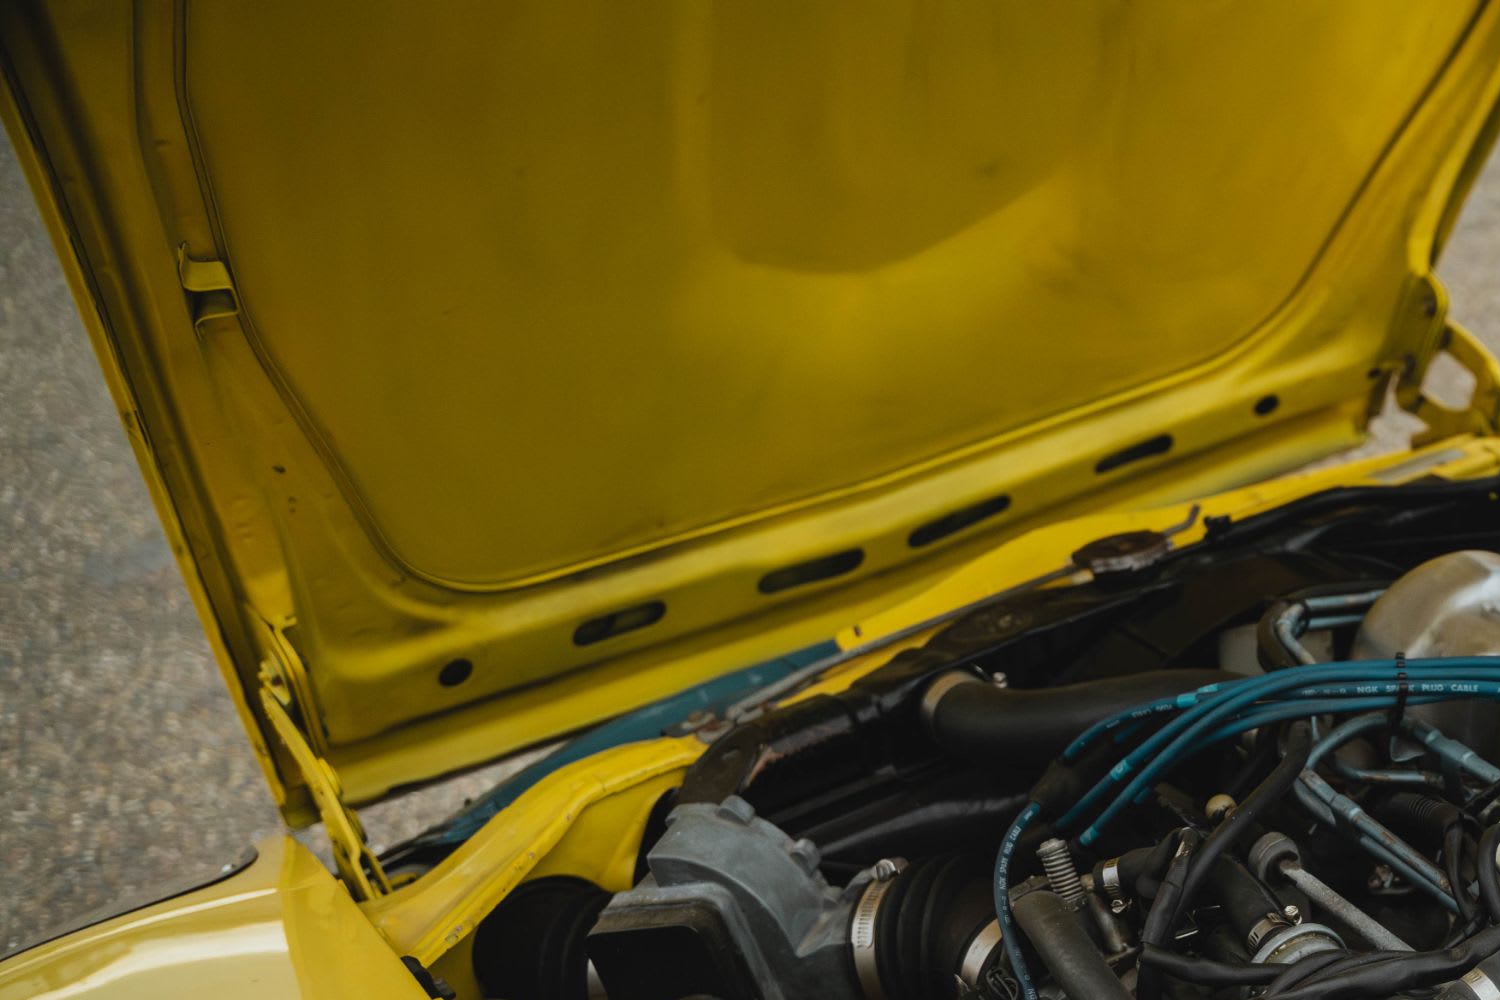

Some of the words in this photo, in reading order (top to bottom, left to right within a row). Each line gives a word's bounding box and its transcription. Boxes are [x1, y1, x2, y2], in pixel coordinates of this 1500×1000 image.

[1356, 685, 1379, 695] NGK
[1385, 684, 1416, 693] SPAK
[1421, 683, 1445, 693] PLUG
[1450, 683, 1480, 693] CABLE
